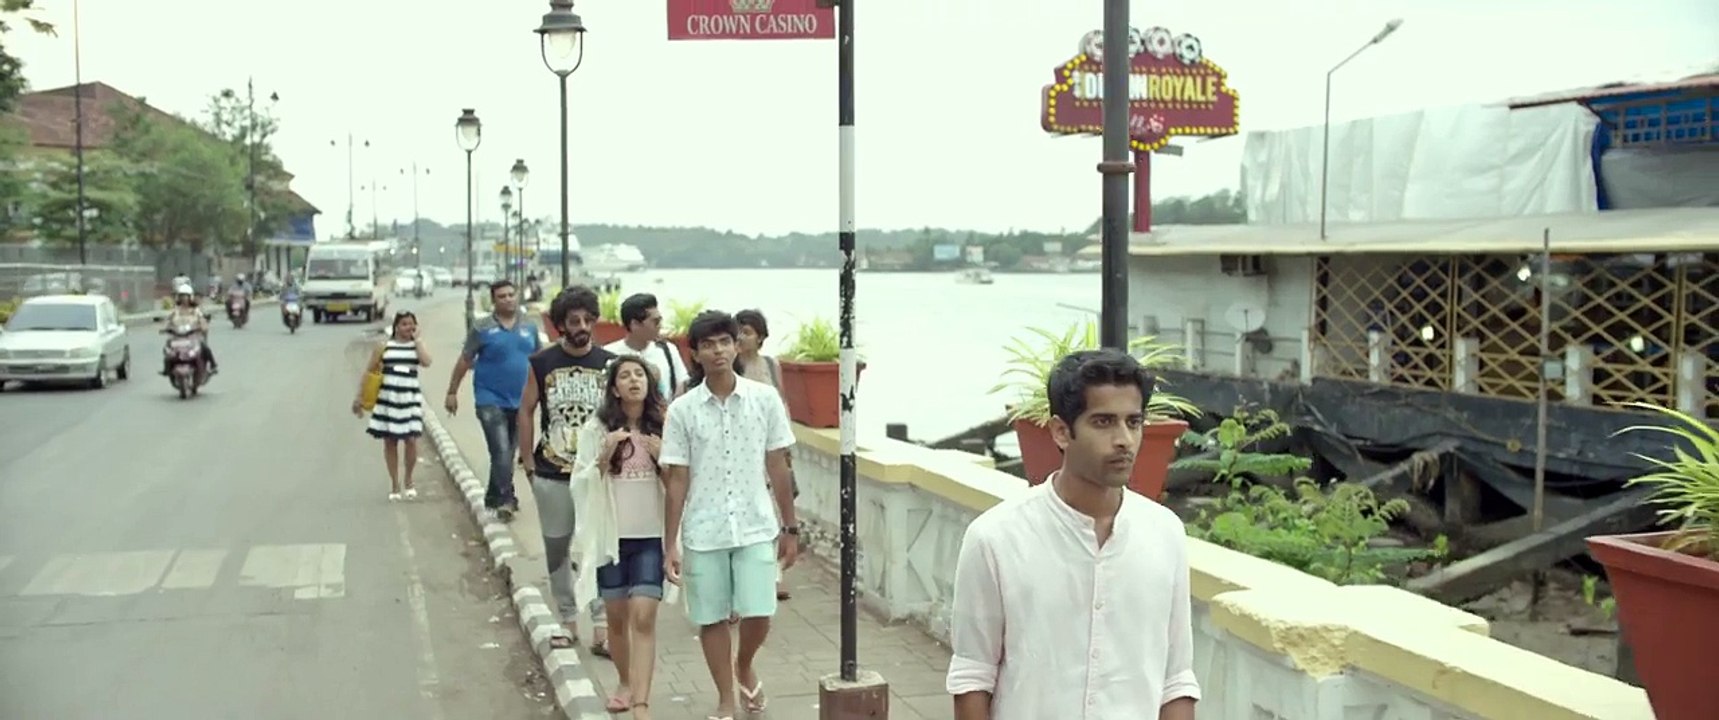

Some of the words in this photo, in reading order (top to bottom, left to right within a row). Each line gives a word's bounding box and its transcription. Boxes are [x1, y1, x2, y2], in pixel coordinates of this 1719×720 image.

[686, 14, 750, 35] CROWN
[754, 13, 817, 34] CASINO
[1148, 73, 1218, 102] ROYALE
